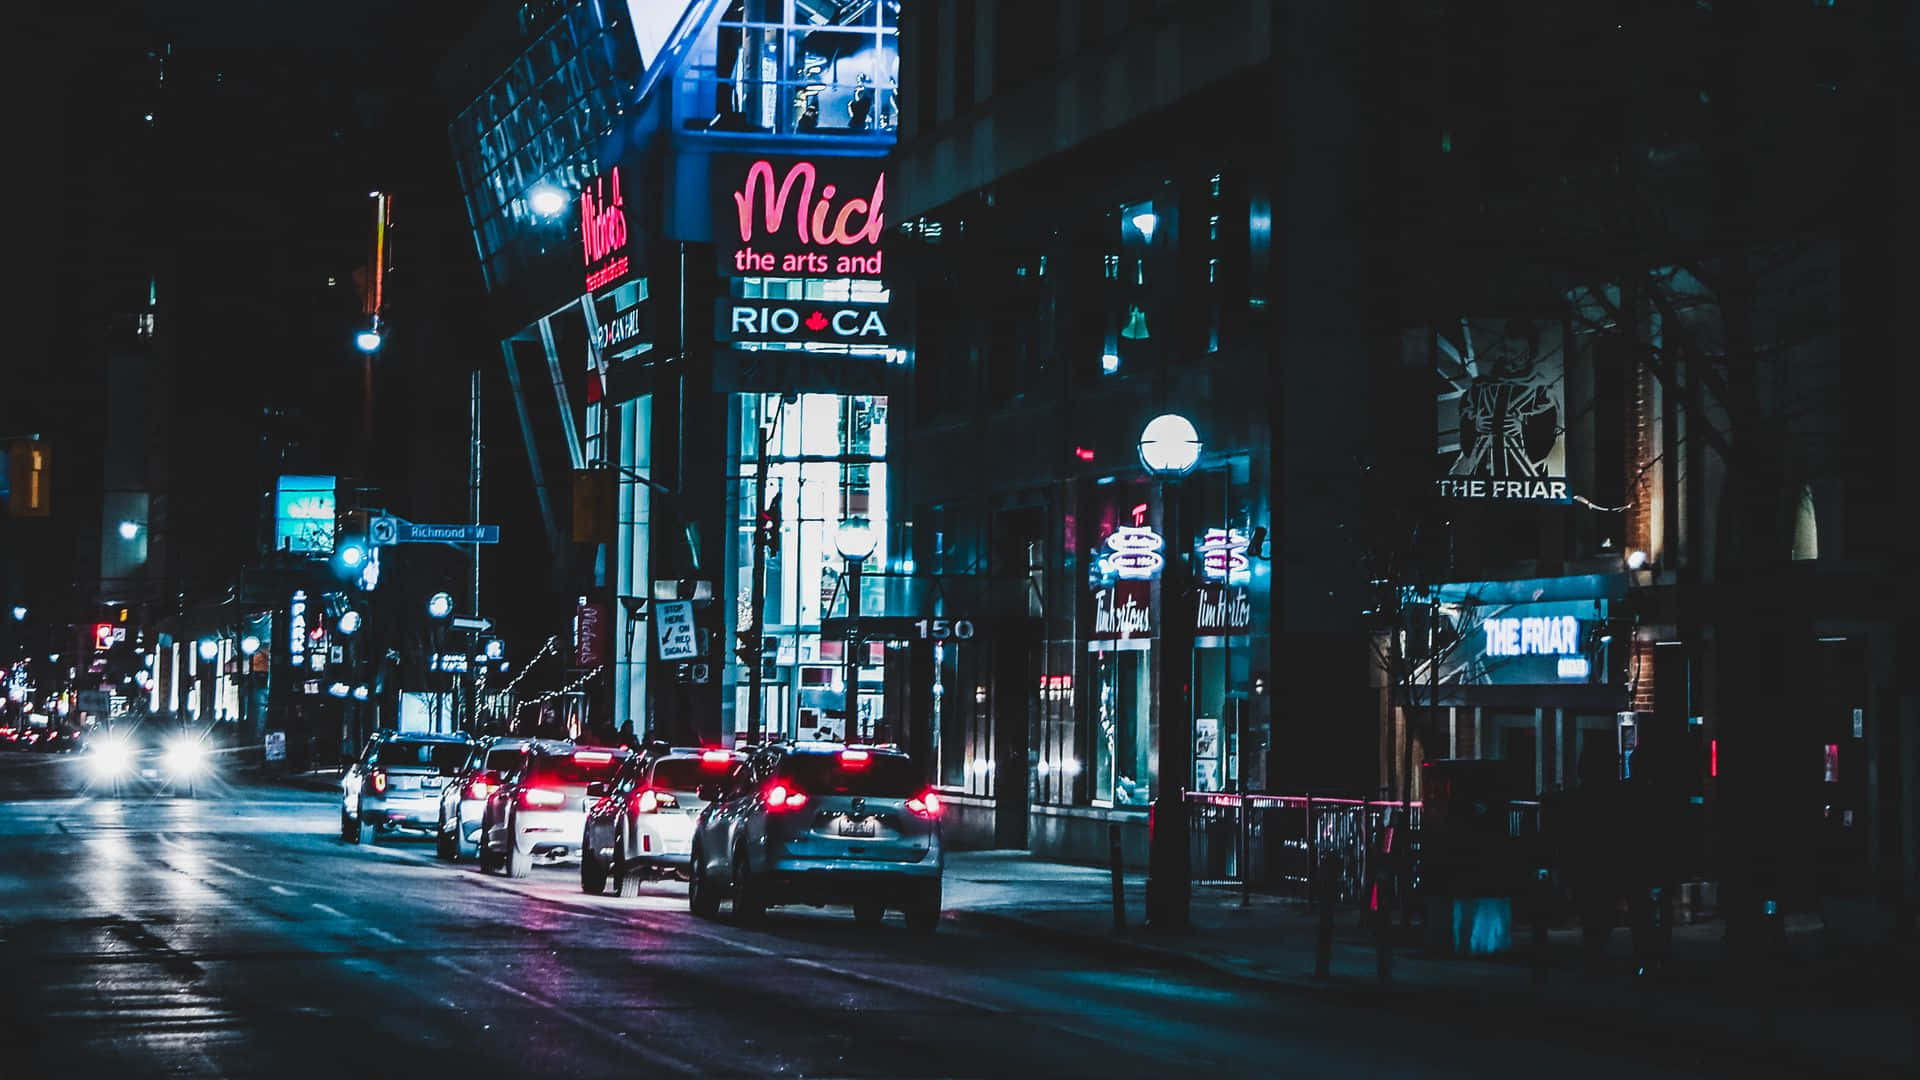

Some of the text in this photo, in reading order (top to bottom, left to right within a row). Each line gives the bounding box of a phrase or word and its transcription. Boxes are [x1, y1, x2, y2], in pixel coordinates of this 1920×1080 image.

[735, 247, 882, 274] the arts and
[731, 306, 888, 336] RIO CA
[1436, 479, 1568, 499] THE FRIAR
[411, 527, 465, 539] Richmond
[475, 527, 486, 538] W
[1197, 588, 1216, 628] Tim
[678, 624, 690, 633] ON
[915, 619, 974, 640] 150
[1484, 615, 1577, 656] THE FRIAR
[675, 634, 691, 645] RED
[664, 646, 693, 656] SIGNAL
